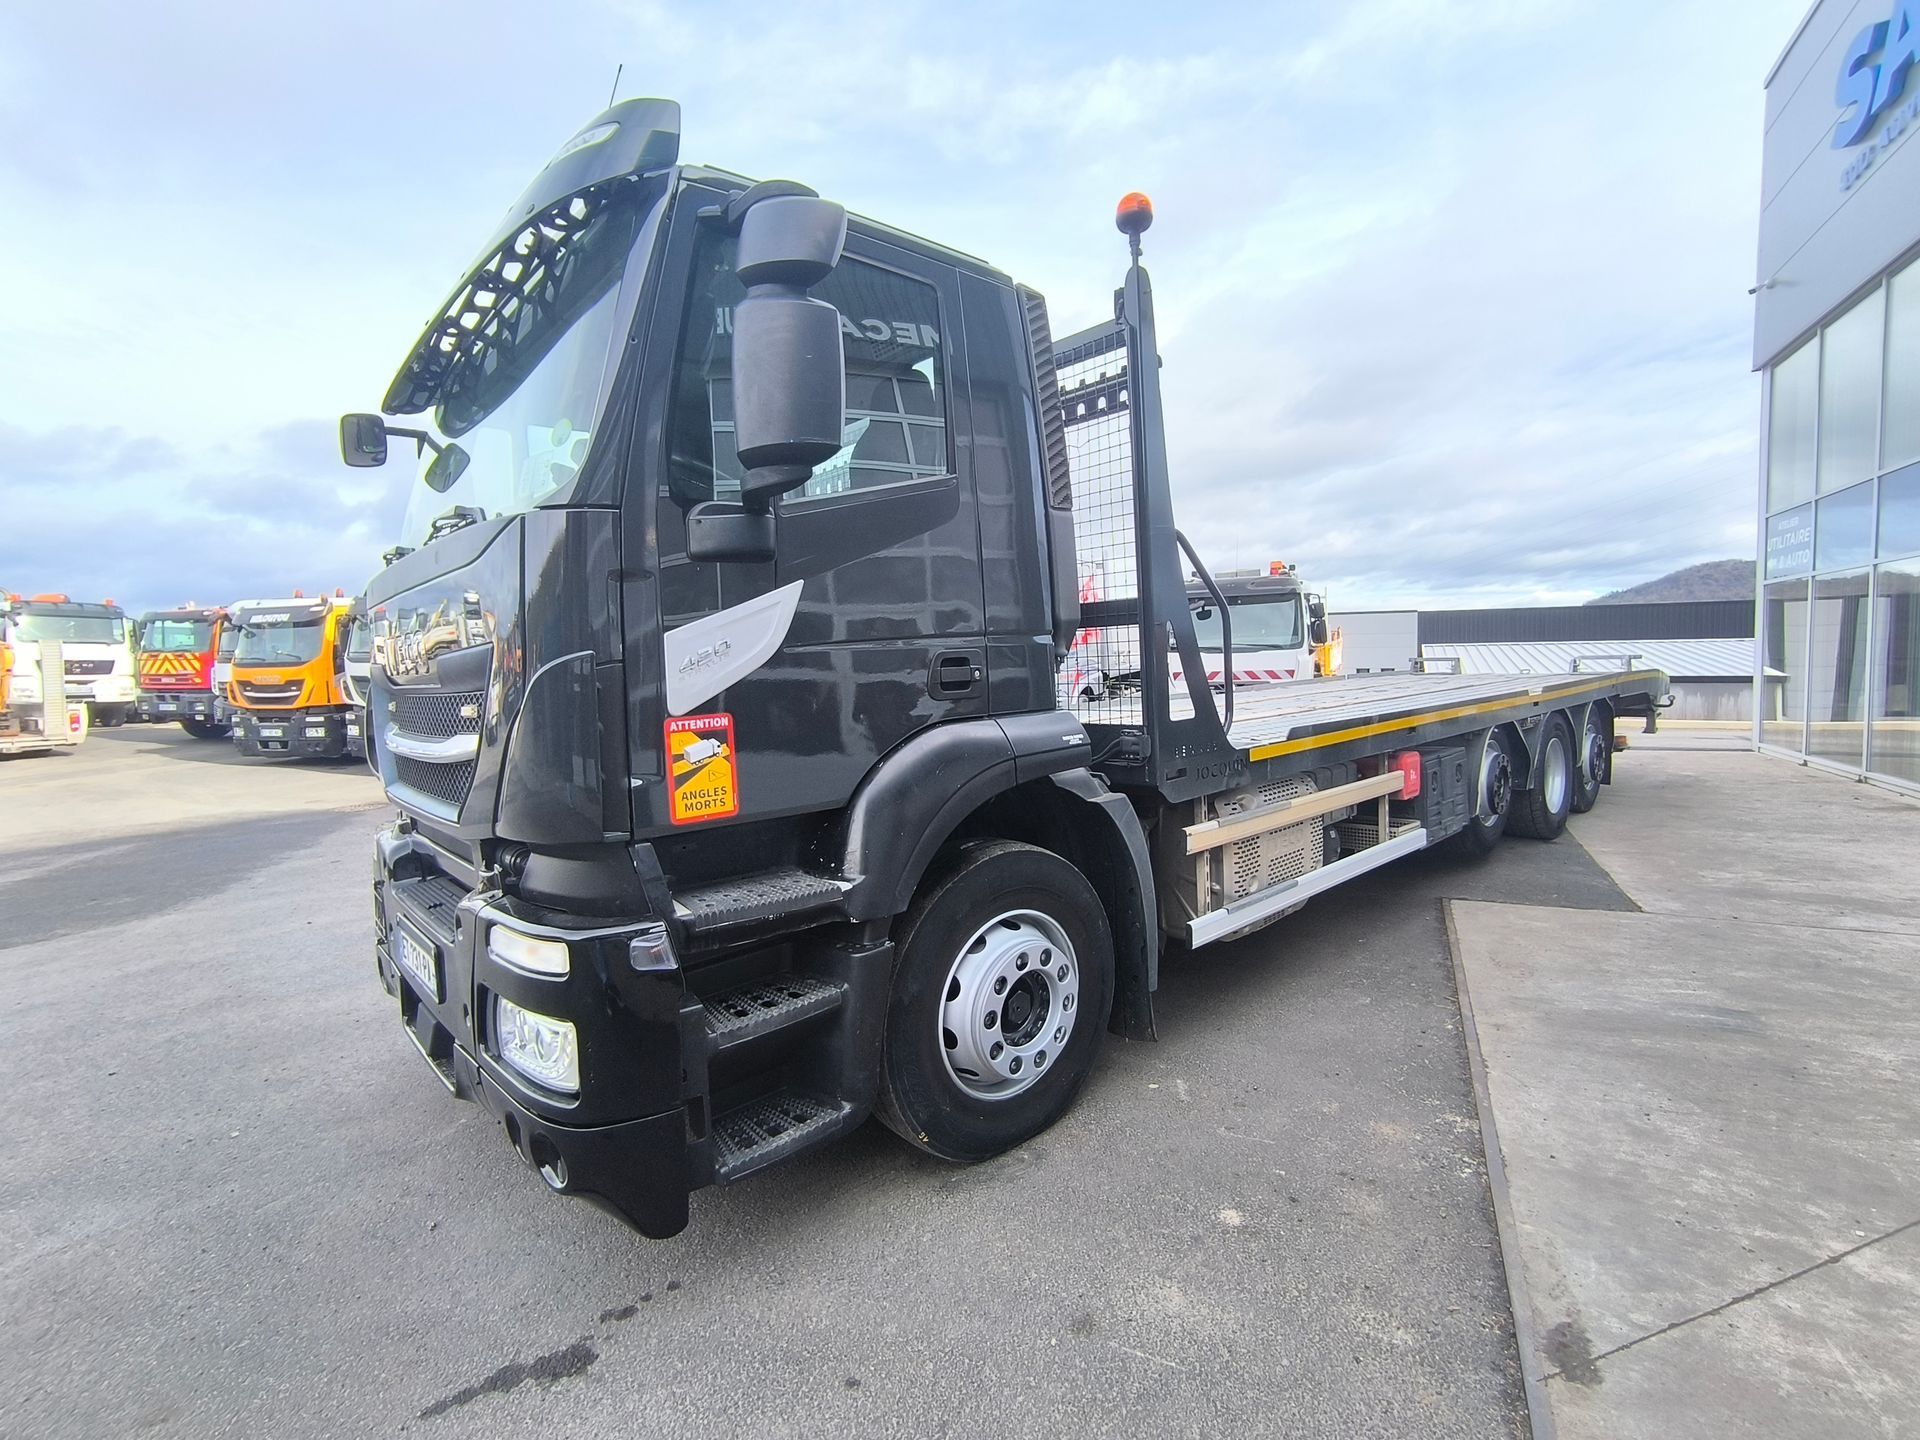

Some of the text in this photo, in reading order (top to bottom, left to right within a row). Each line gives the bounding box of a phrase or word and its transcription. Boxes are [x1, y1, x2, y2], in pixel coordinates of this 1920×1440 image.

[1767, 527, 1811, 551] UTILITAIRE
[669, 716, 729, 732] ATTENTION
[681, 785, 728, 802] ANGLES
[684, 797, 726, 813] MORTS
